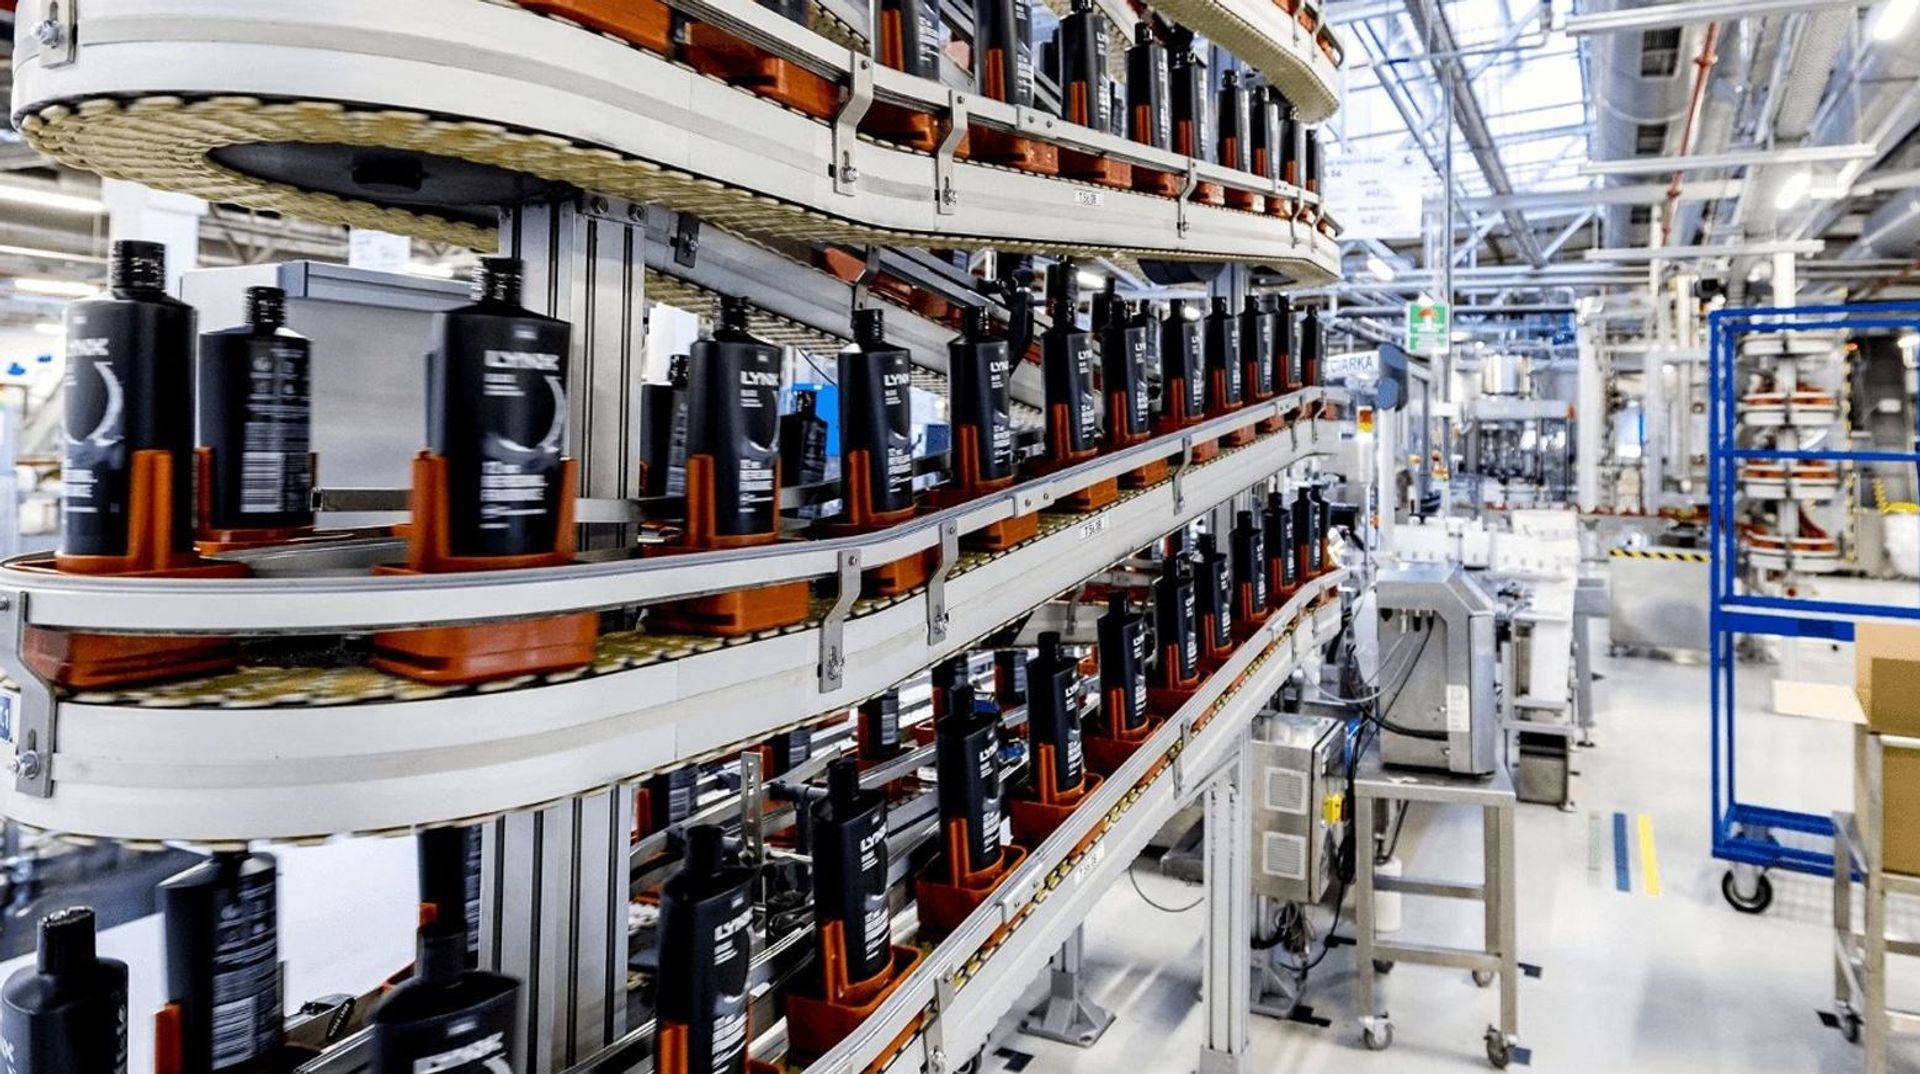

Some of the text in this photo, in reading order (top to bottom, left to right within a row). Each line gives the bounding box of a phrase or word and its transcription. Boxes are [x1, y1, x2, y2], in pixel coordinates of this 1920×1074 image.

[66, 337, 110, 356] YNX
[484, 350, 560, 371] LYNX
[990, 361, 1009, 372] LYN
[740, 371, 779, 386] LYNX
[714, 906, 754, 942] LYNX
